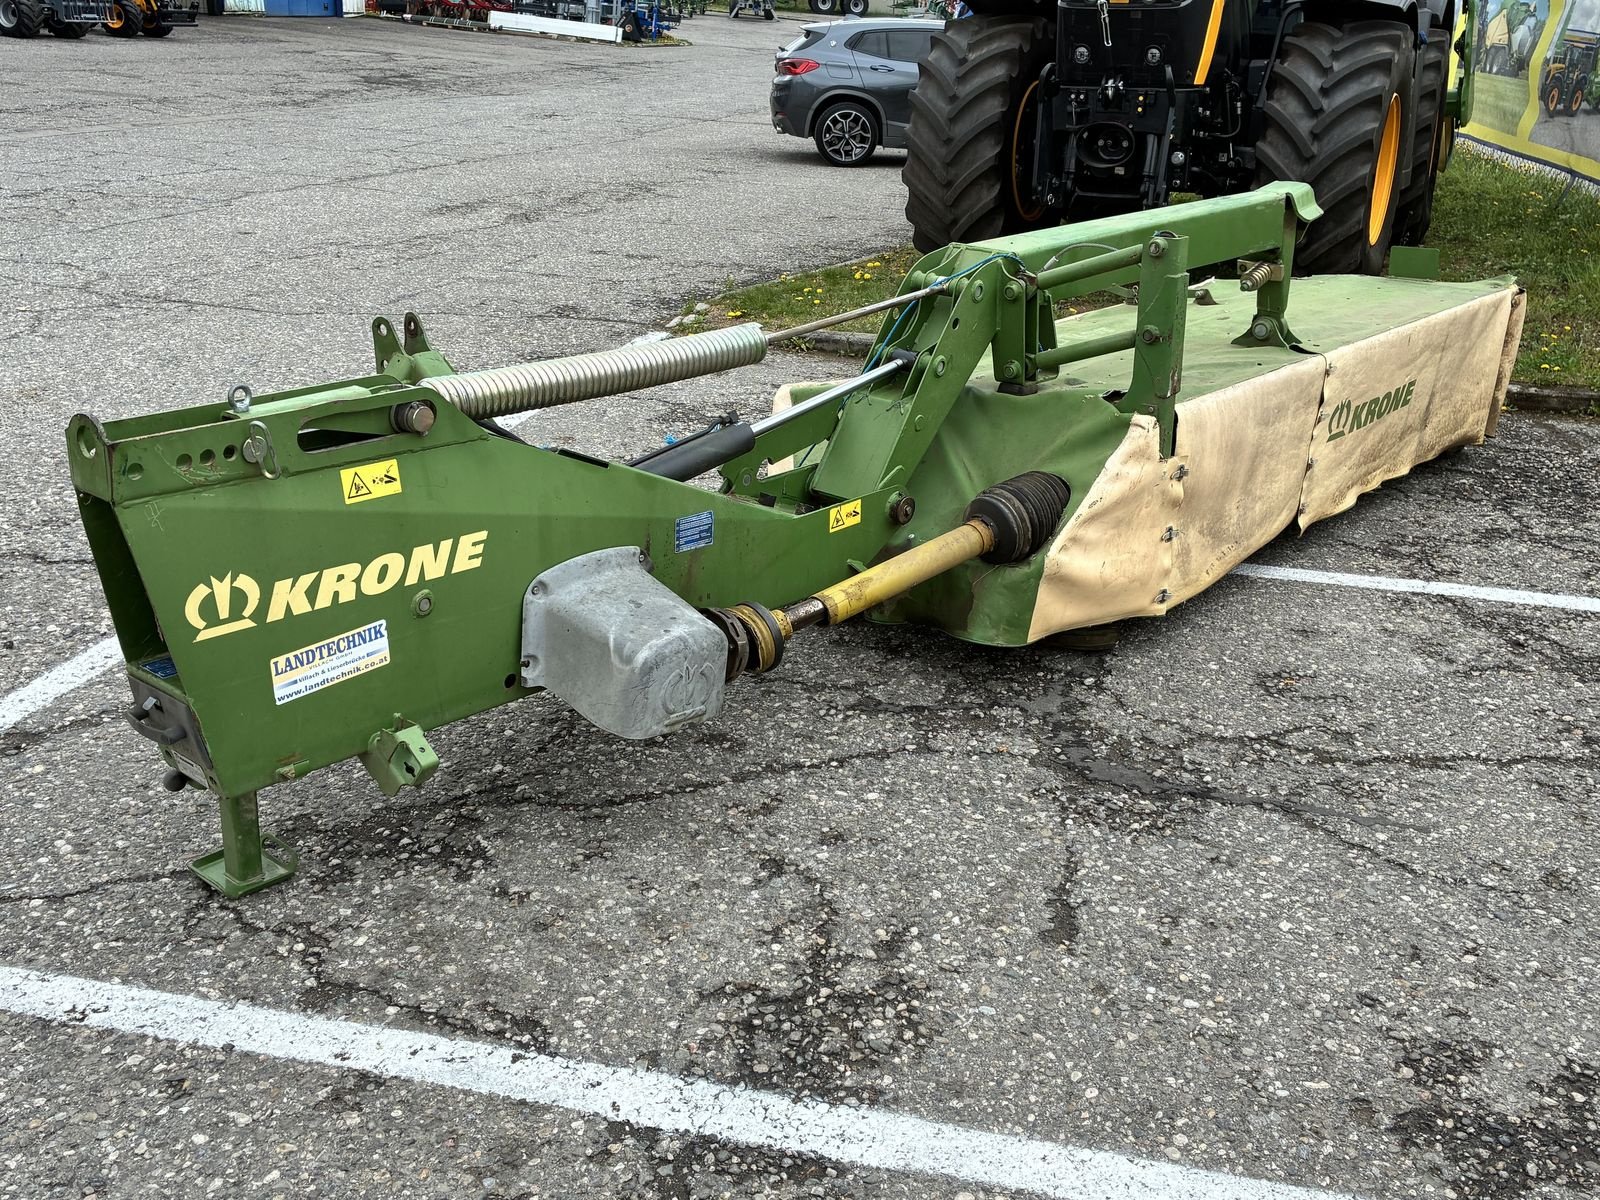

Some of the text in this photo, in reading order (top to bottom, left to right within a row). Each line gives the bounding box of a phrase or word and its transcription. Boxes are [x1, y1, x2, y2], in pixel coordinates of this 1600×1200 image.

[1348, 379, 1417, 434] KRONE
[266, 530, 488, 623] KRONE
[273, 623, 385, 676] LANDTECHNIK
[298, 672, 320, 683] Villach
[327, 655, 366, 673] Lieserbrücke
[277, 656, 389, 702] www.landtechnik.co.at
